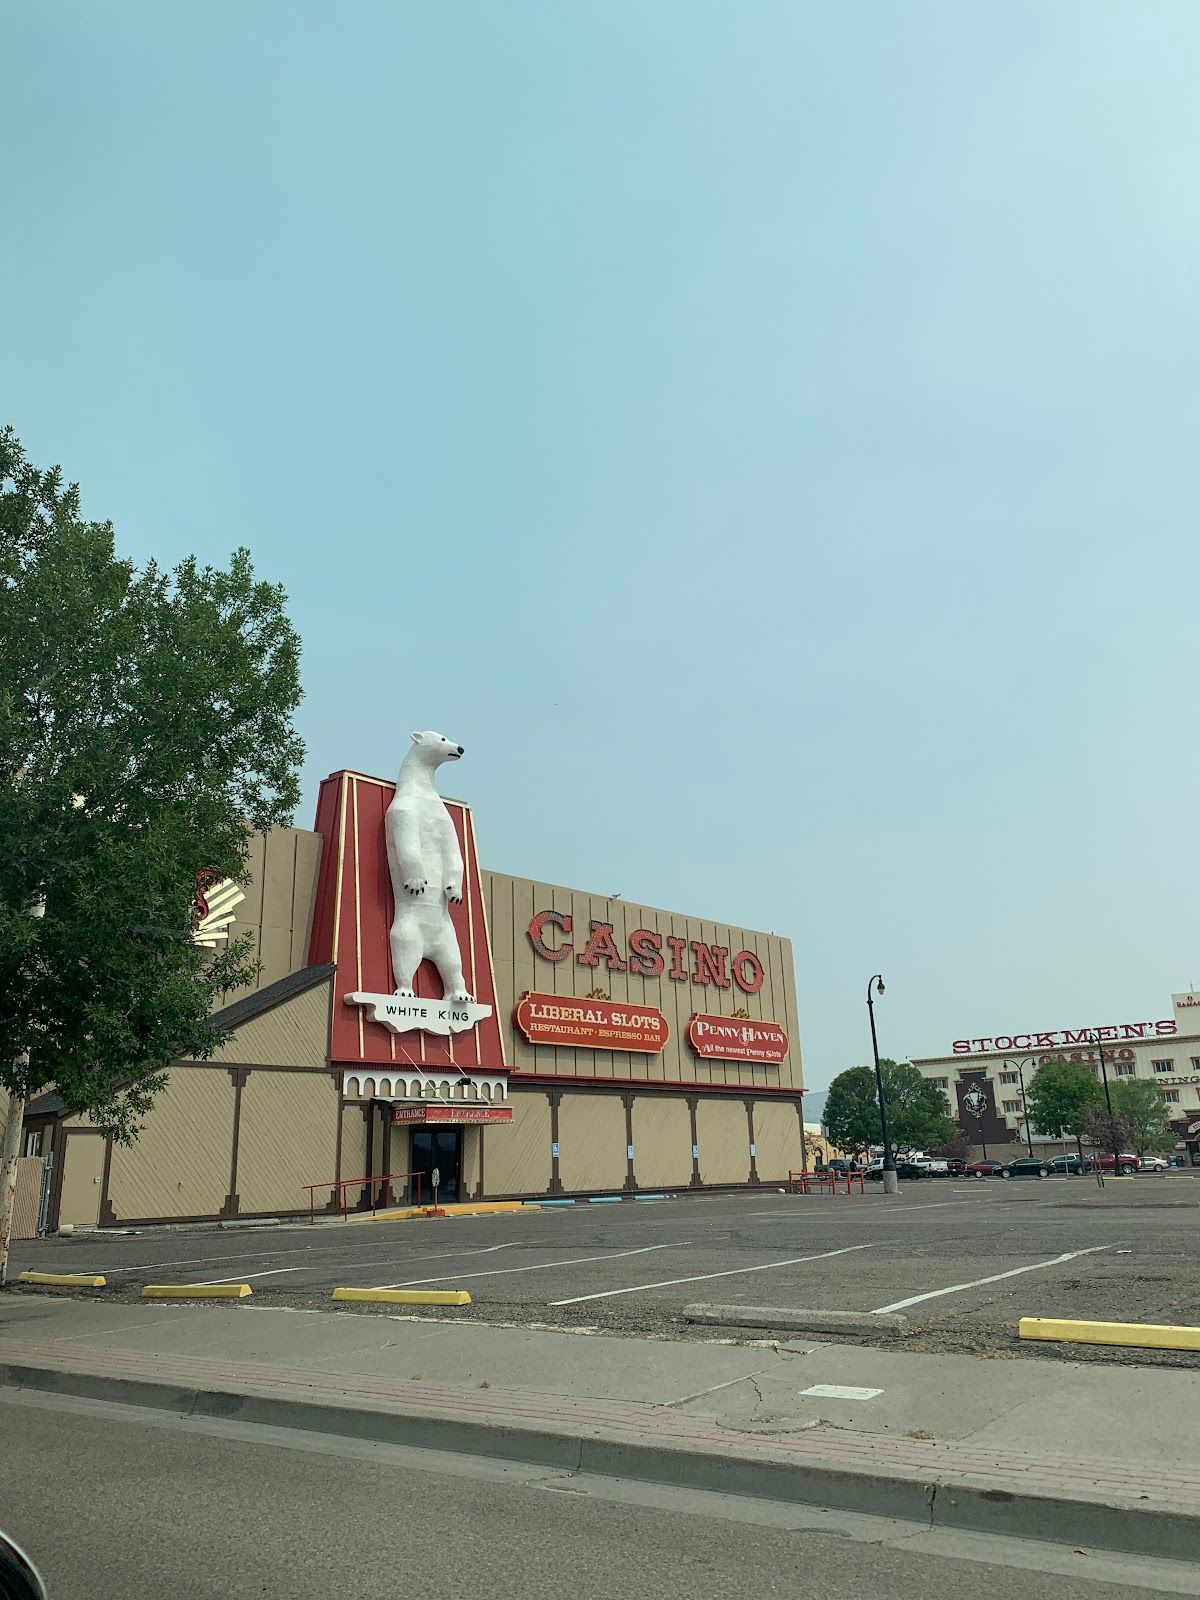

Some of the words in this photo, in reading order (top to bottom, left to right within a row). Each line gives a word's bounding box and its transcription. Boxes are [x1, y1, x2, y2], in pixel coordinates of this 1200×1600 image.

[527, 910, 765, 994] CASINO
[386, 1005, 428, 1018] WHITE
[438, 1010, 469, 1021] KING
[529, 1003, 608, 1025] LIBERAL
[611, 1012, 661, 1030] SLOTS
[529, 1022, 594, 1036] RESTAURANT
[598, 1029, 643, 1040] ESPRESSO
[643, 1033, 661, 1042] BAR
[697, 1021, 740, 1038] PENNY
[739, 1026, 784, 1046] HAVEN
[952, 1019, 1178, 1054] STOCKMEN'S
[702, 1044, 714, 1053] All
[714, 1045, 725, 1053] the
[725, 1047, 746, 1055] newest
[746, 1048, 765, 1058] Penny
[765, 1050, 782, 1059] Slots
[395, 1108, 426, 1119] ENTRANCE
